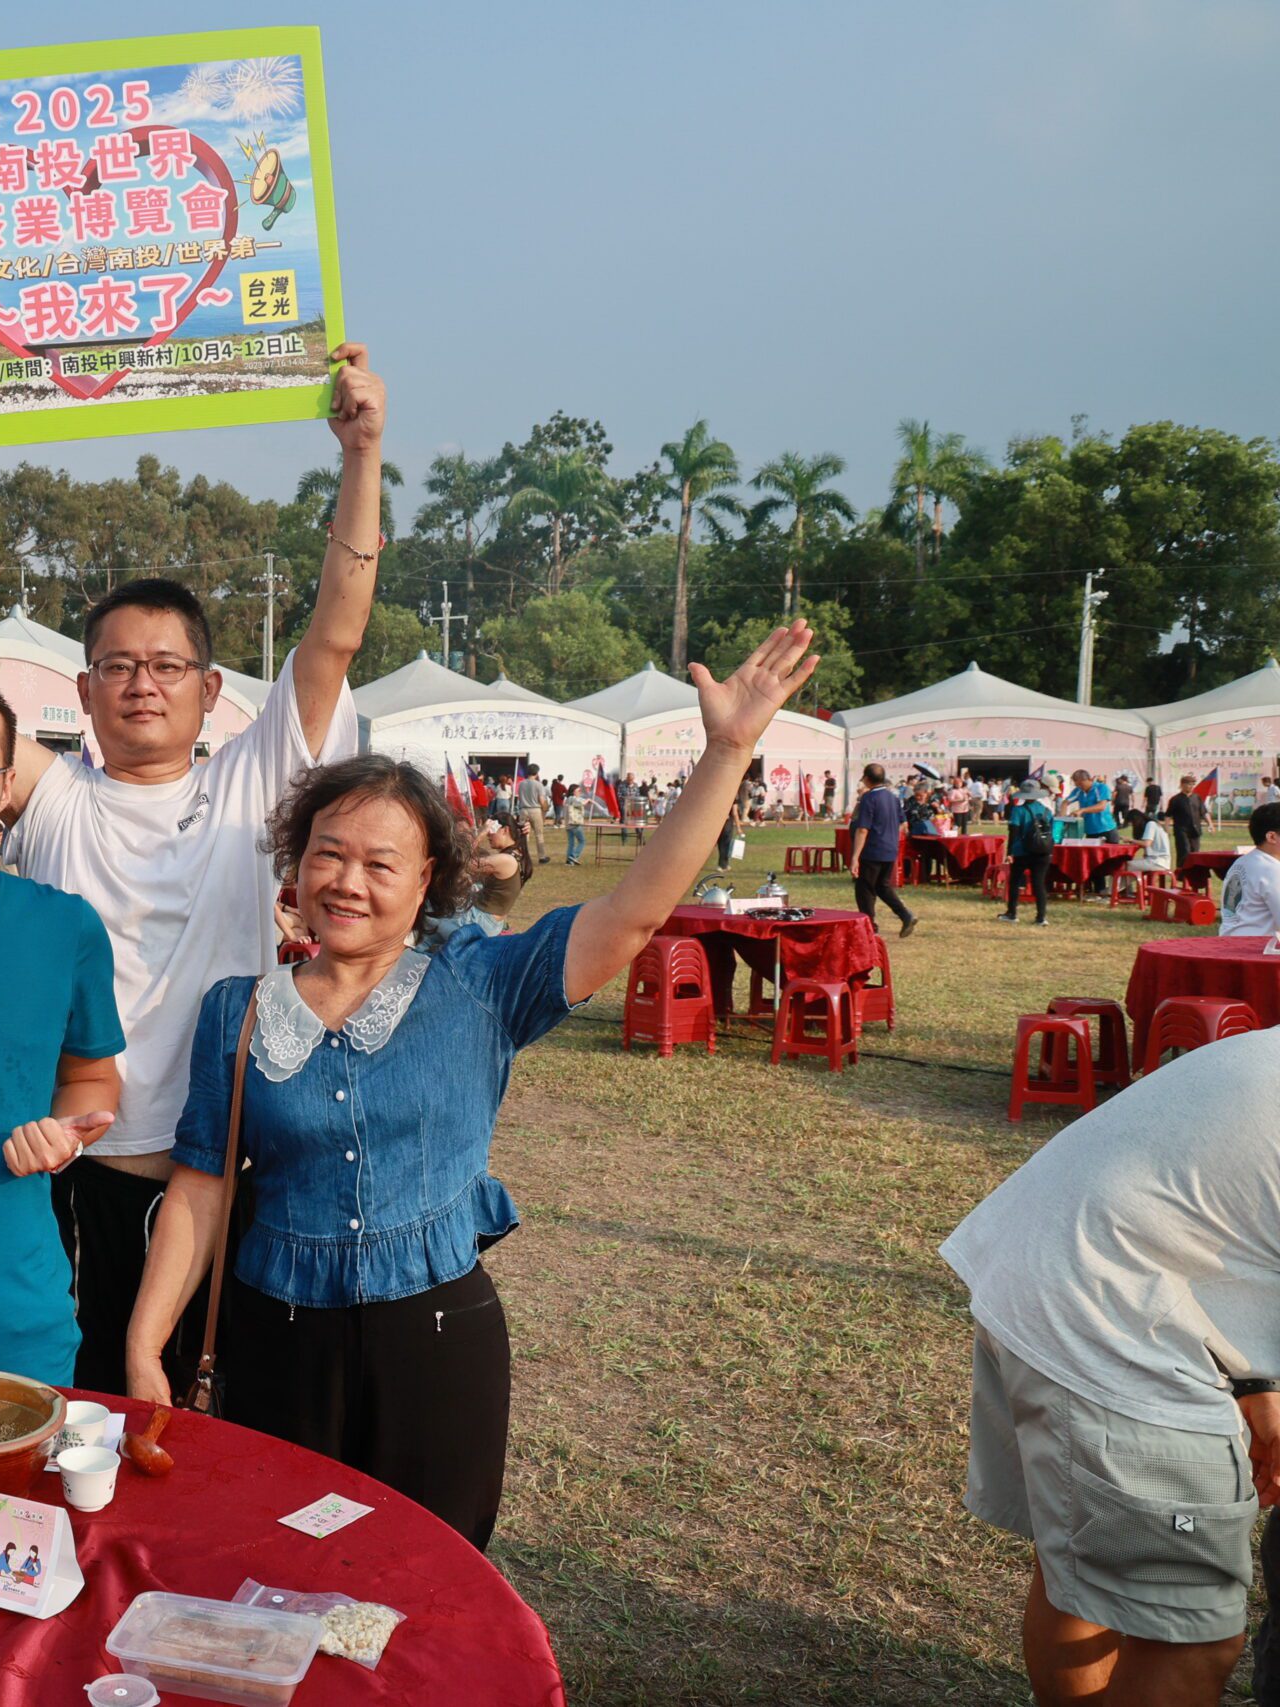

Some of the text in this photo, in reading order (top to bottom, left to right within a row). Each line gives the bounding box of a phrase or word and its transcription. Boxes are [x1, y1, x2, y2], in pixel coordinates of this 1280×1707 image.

[13, 82, 151, 133] 2025
[249, 276, 289, 298] 台灣
[249, 297, 290, 317] 之光
